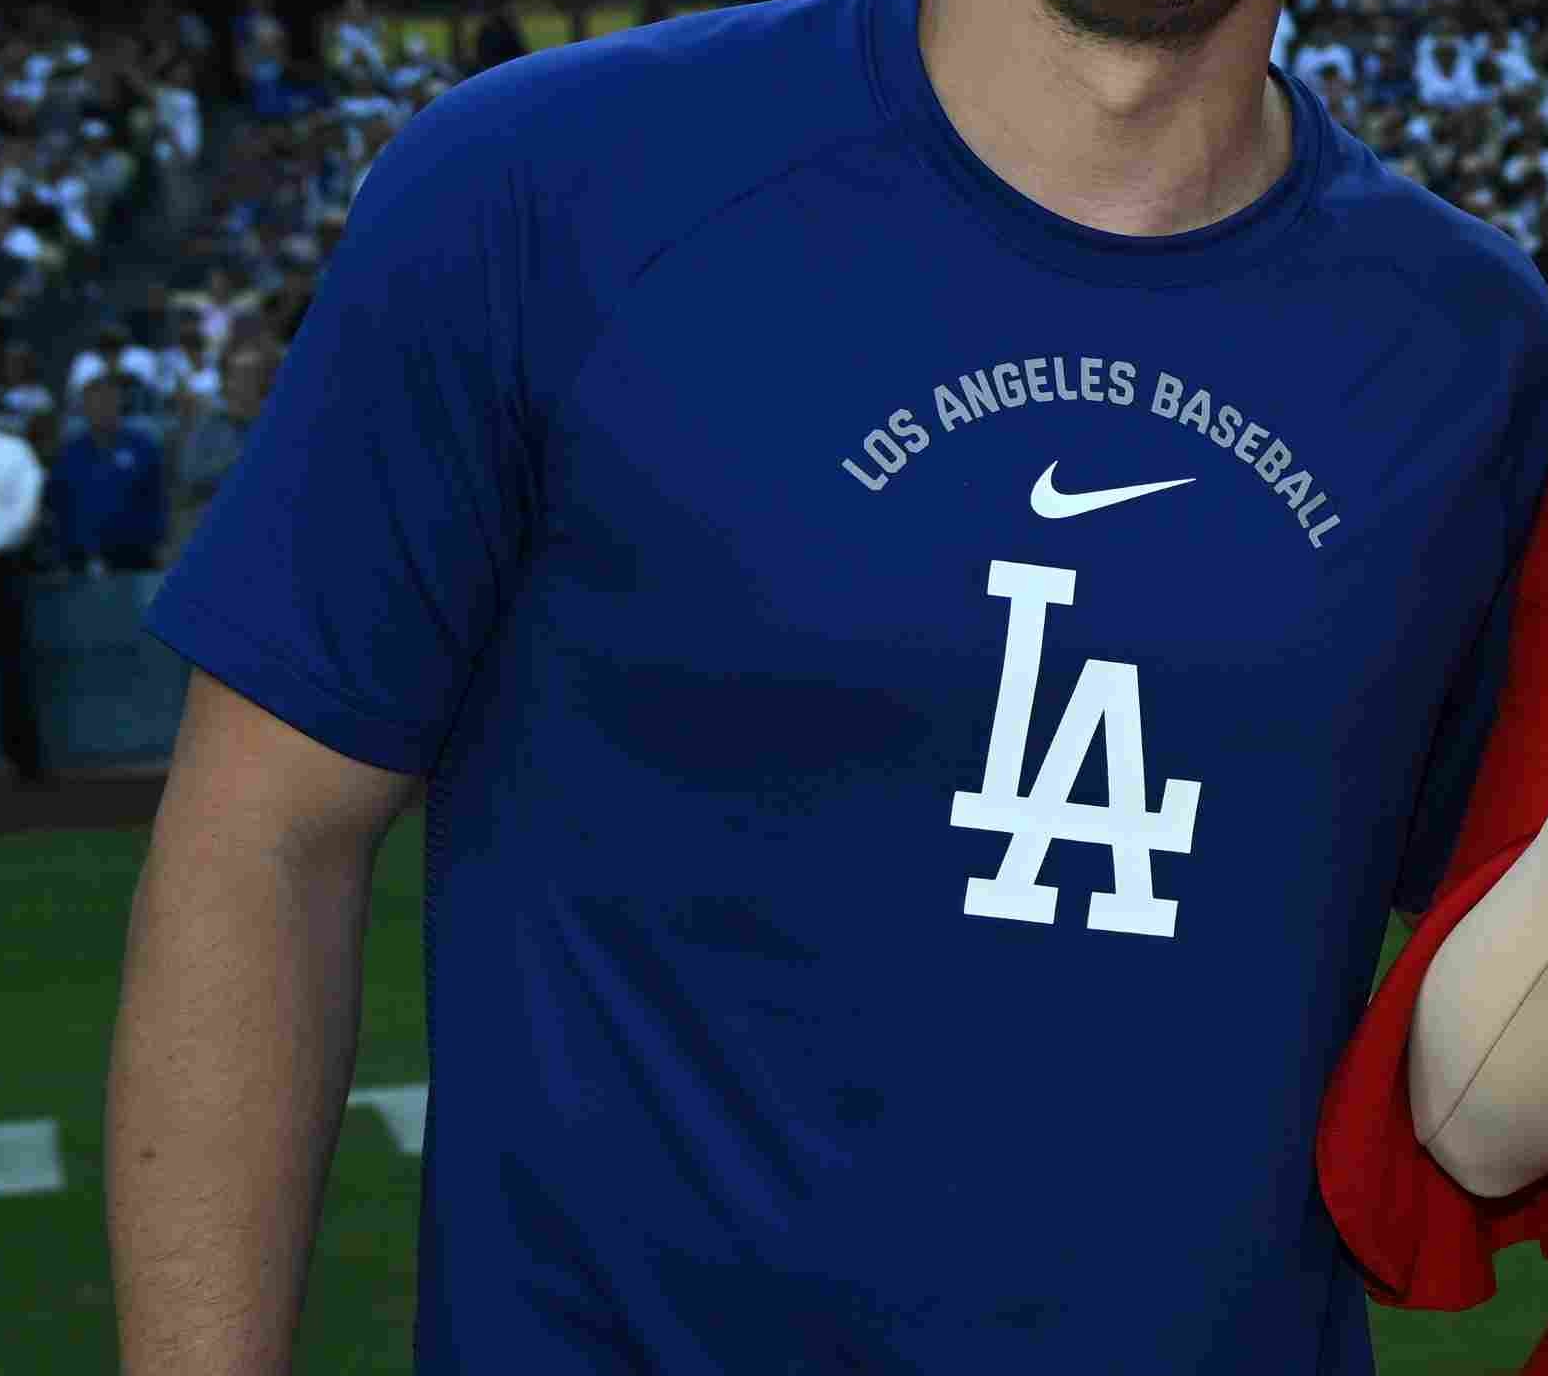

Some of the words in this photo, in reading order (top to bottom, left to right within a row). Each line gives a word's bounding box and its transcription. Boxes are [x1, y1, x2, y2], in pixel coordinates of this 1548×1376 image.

[842, 408, 930, 491] LOS
[933, 357, 1136, 432] ANGELES
[1151, 372, 1341, 549] BASEBALL
[950, 560, 1202, 938] LA
